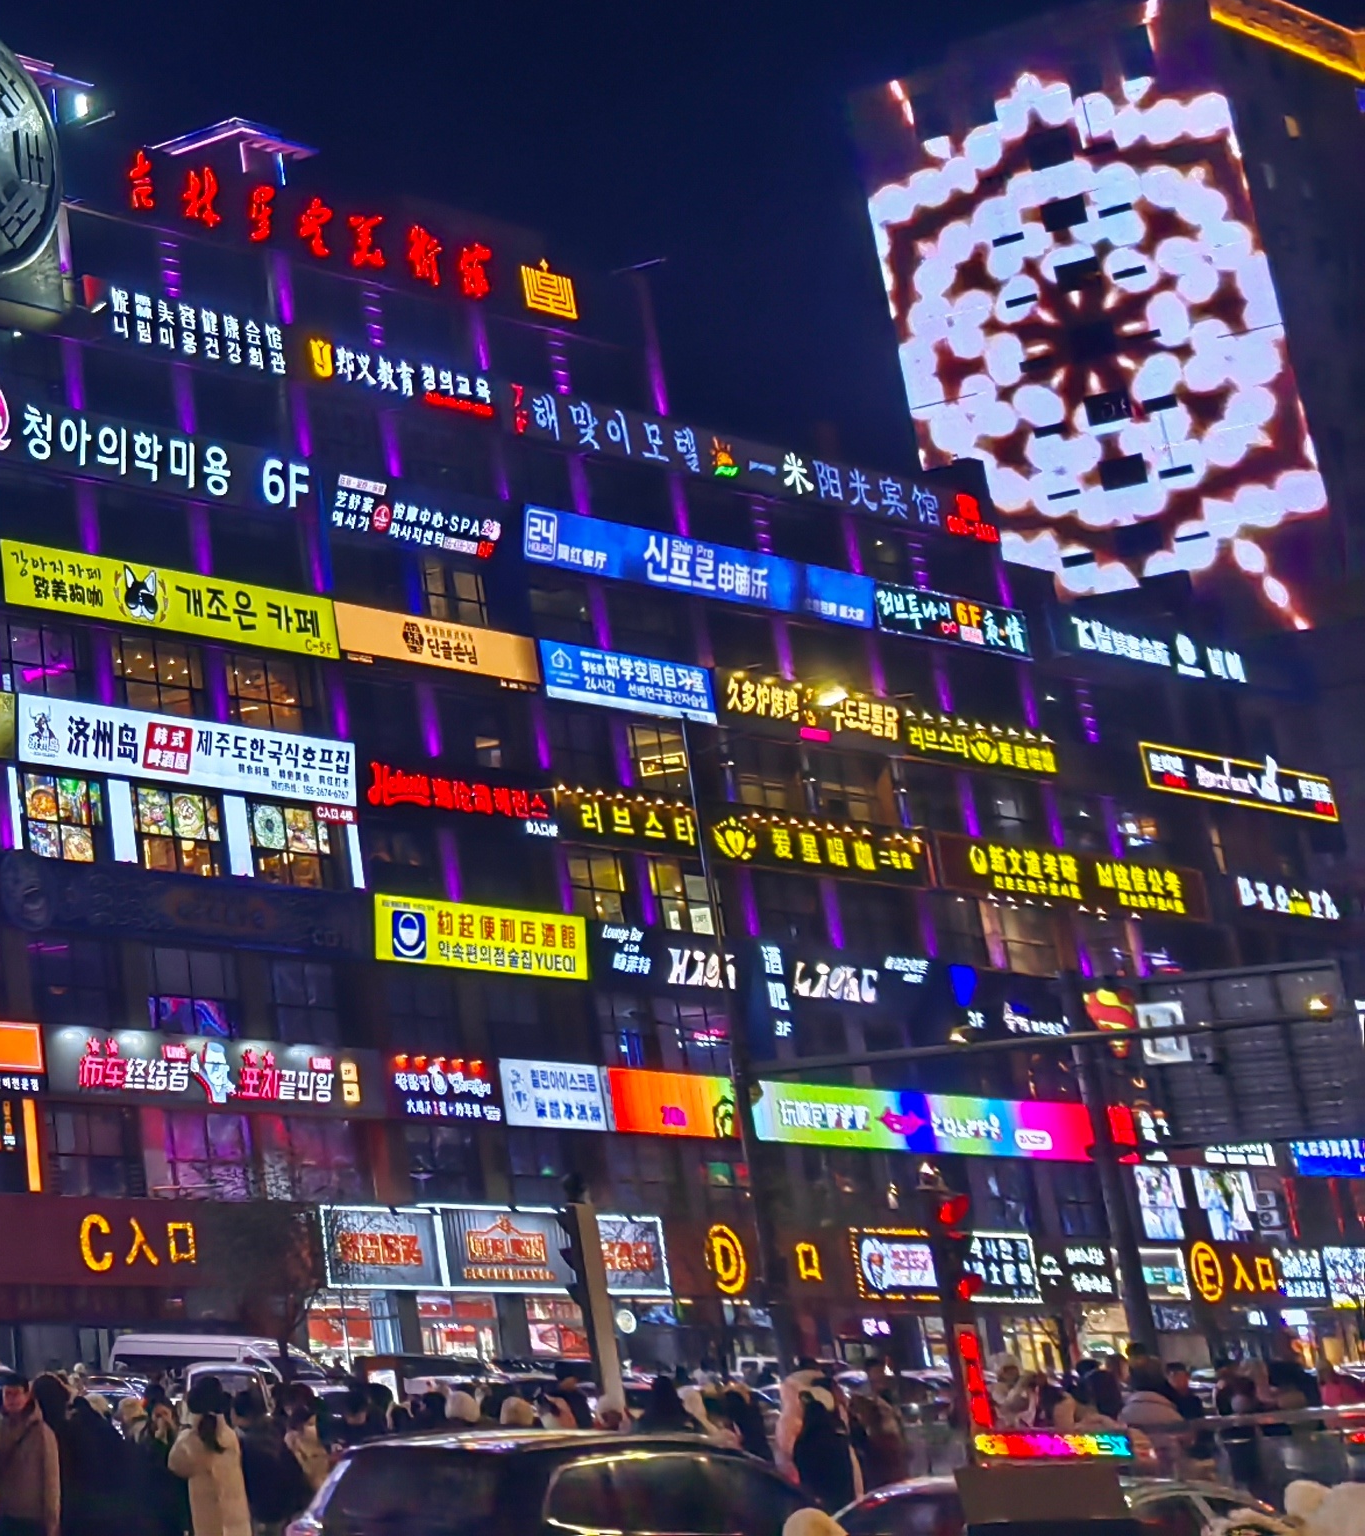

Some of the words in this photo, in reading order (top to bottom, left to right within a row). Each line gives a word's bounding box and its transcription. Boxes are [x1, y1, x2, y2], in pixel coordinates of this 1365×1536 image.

[23, 405, 232, 498] 청아의학미용
[262, 459, 310, 508] 6F
[528, 516, 555, 540] 24
[643, 533, 717, 591] 신프로
[672, 540, 693, 554] Shin
[696, 544, 715, 559] Pro
[175, 584, 257, 632] 개조은
[266, 601, 320, 639] 카페
[956, 602, 982, 628] 6F
[67, 715, 139, 765] 济州岛
[153, 725, 187, 748] 韩式
[195, 729, 352, 775] 제주도한국식호프집
[146, 748, 189, 771] 啤酒屋
[580, 802, 695, 846] 러브스타
[437, 910, 576, 950] 約起便利店酒館
[535, 951, 577, 973] YUEQI
[126, 1216, 196, 1266] 入口
[1232, 1251, 1277, 1292] 入口
